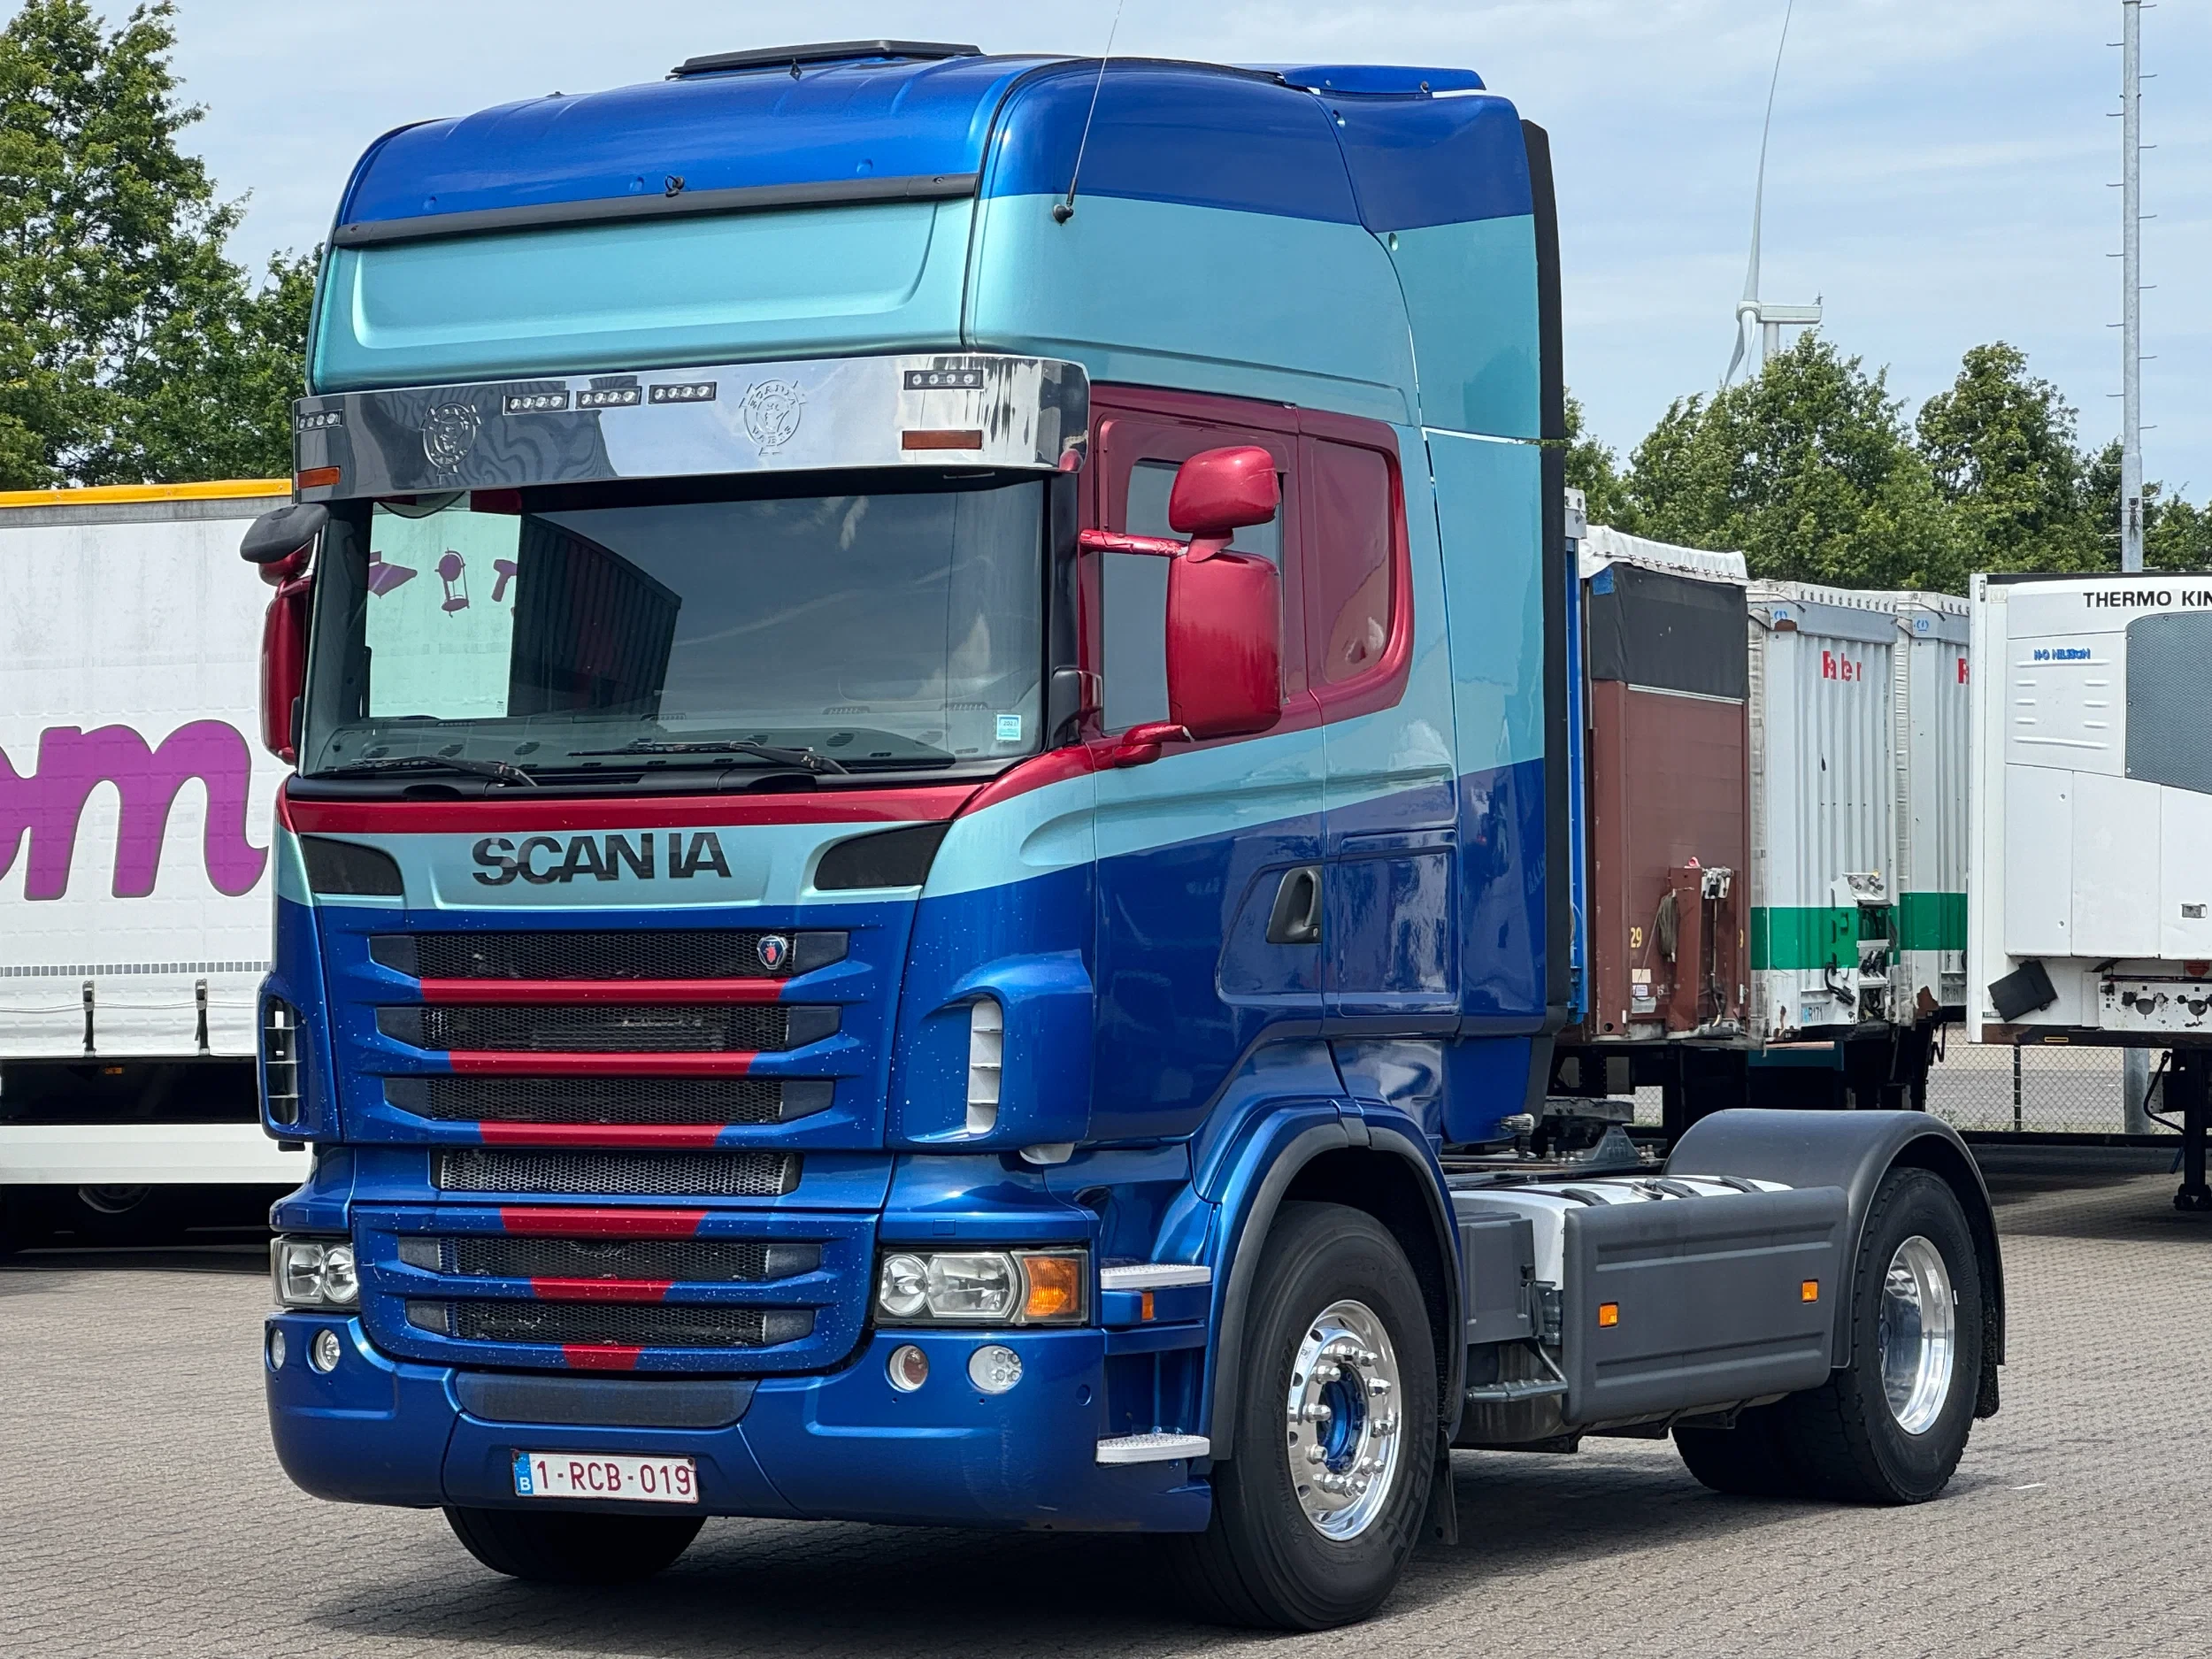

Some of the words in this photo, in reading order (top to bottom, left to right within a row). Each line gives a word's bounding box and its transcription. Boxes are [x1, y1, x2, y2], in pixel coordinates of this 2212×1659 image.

[2083, 590, 2172, 608] THERMO
[472, 832, 733, 886] SCANIA
[519, 1477, 531, 1491] B
[536, 1460, 691, 1495] 1-RCB-019
